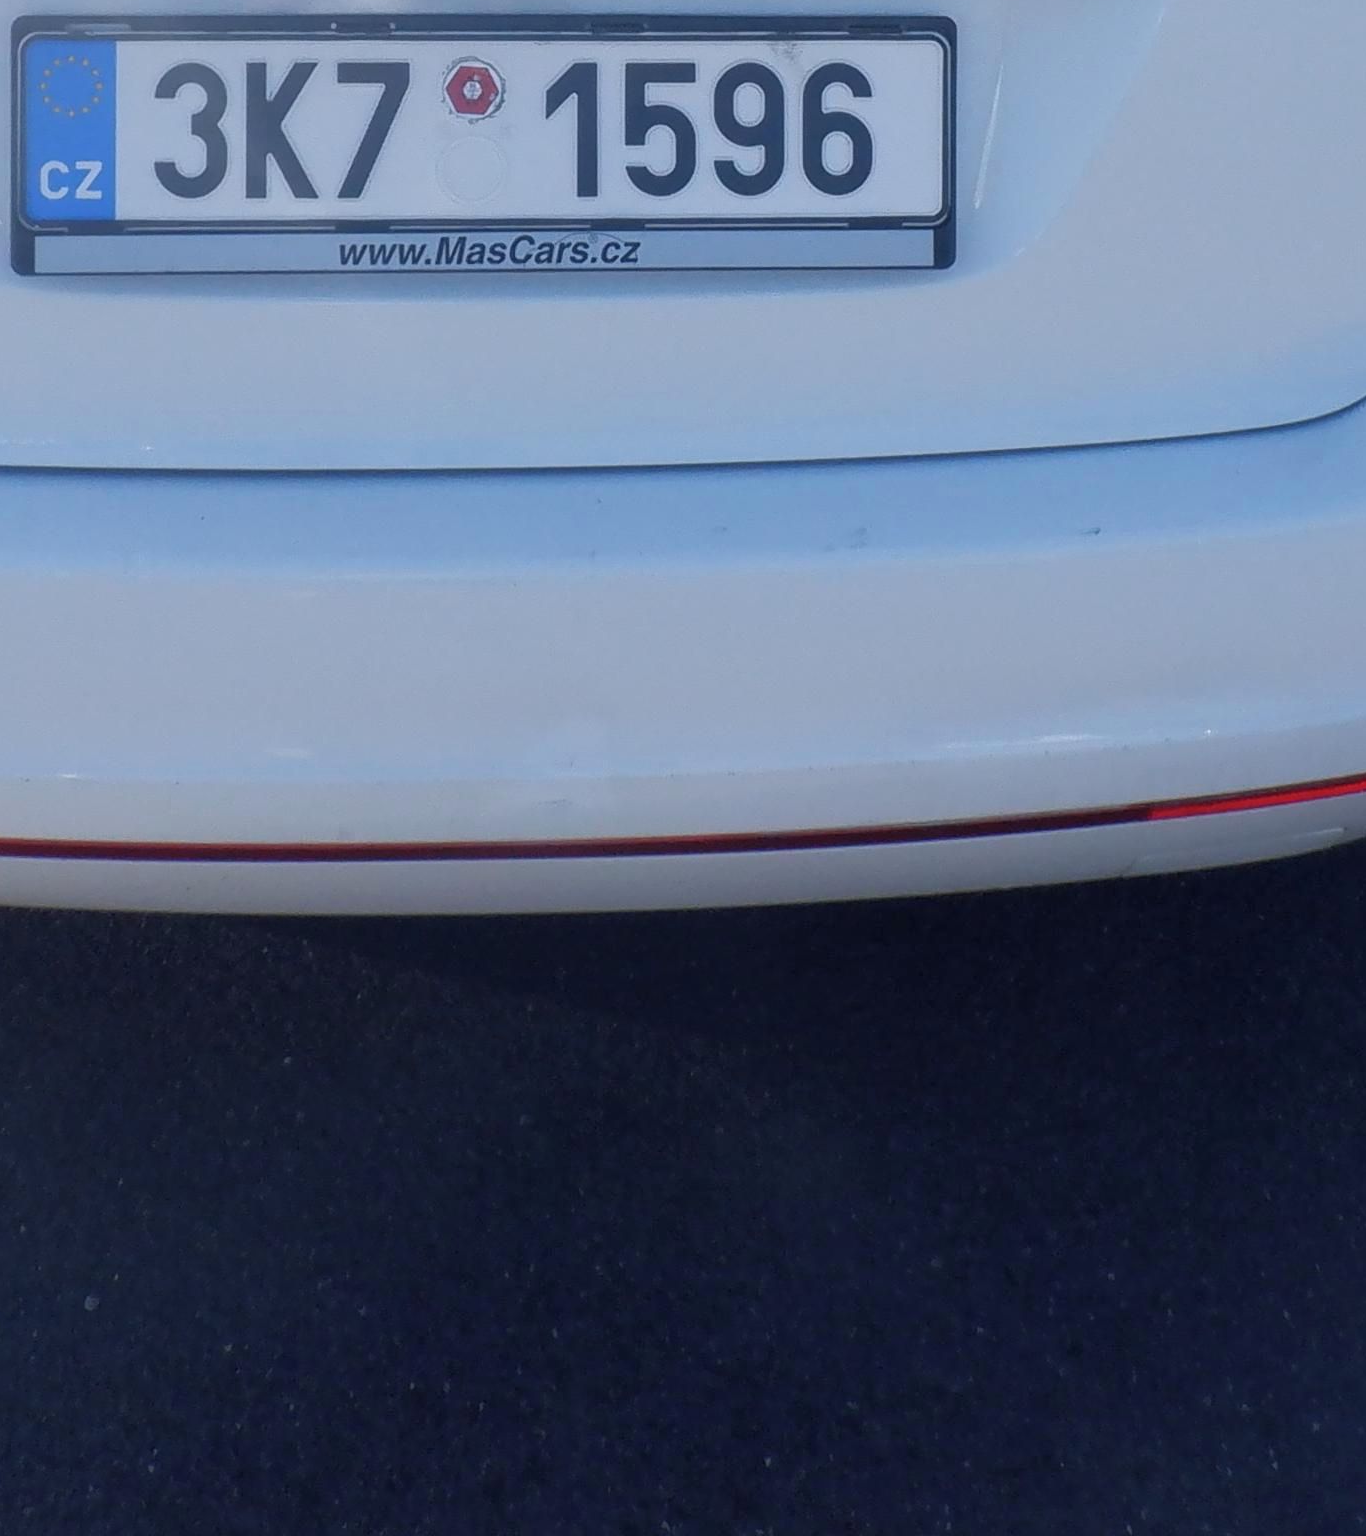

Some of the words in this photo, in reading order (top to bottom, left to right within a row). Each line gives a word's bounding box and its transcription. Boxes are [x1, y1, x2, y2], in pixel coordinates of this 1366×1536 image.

[154, 62, 411, 199] 3K7
[545, 62, 874, 199] 1596
[40, 160, 103, 200] CZ
[339, 234, 642, 266] www.MasCars.cz
